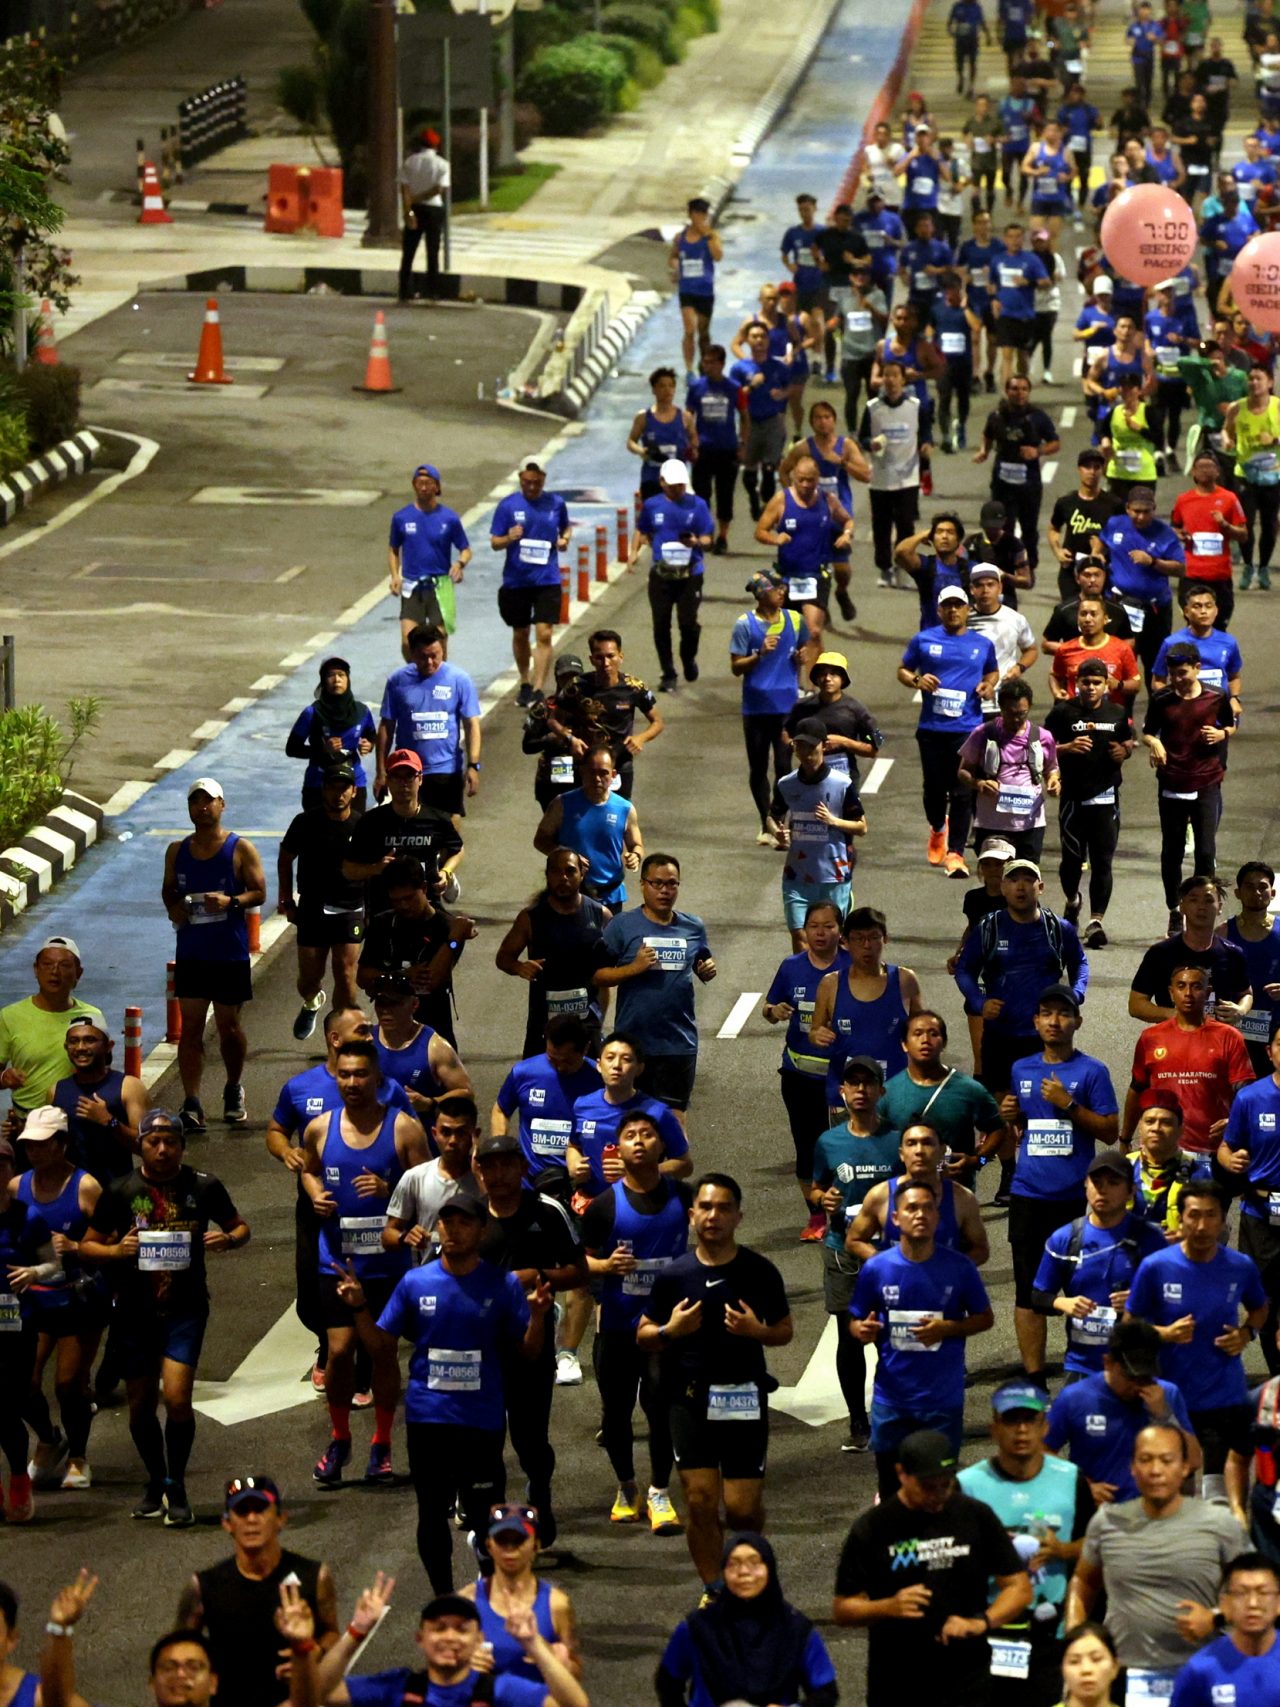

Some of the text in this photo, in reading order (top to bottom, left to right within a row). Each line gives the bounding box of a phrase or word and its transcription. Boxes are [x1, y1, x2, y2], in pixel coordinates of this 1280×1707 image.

[1144, 222, 1189, 240] 7:00
[1139, 243, 1190, 255] SEIKO
[384, 835, 432, 846] ULTRON
[654, 950, 686, 960] M-02701
[1179, 1071, 1217, 1080] MARATHON
[1028, 1133, 1071, 1144] AM-03411
[855, 1164, 892, 1173] RUNLIGA
[623, 1272, 656, 1284] AM-03
